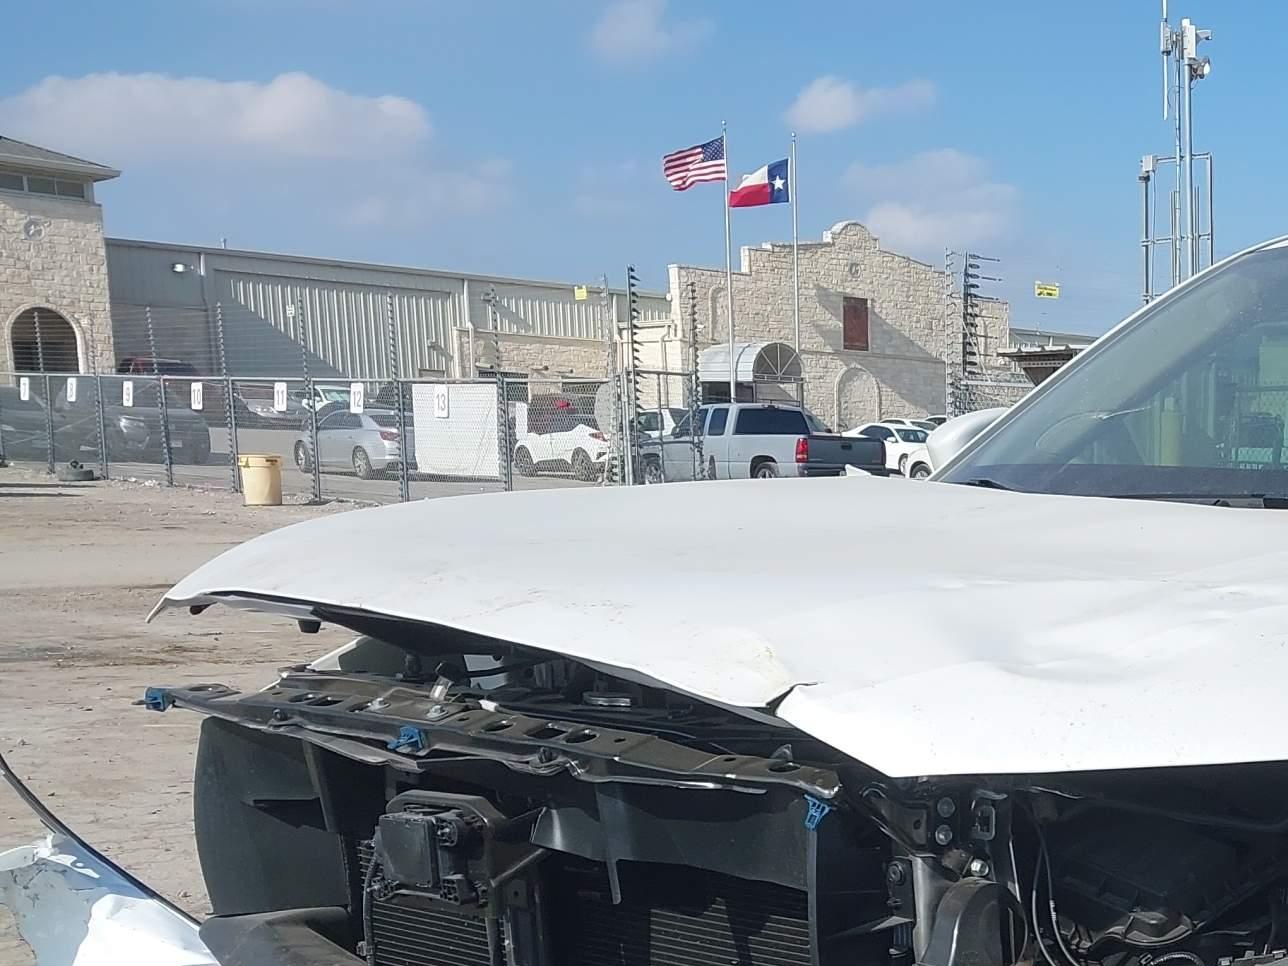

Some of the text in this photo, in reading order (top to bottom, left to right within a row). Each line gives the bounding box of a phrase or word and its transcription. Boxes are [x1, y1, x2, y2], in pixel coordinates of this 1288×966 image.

[192, 389, 201, 405] 10
[277, 390, 284, 406] 11
[353, 391, 362, 408] 12
[436, 393, 446, 411] 13
